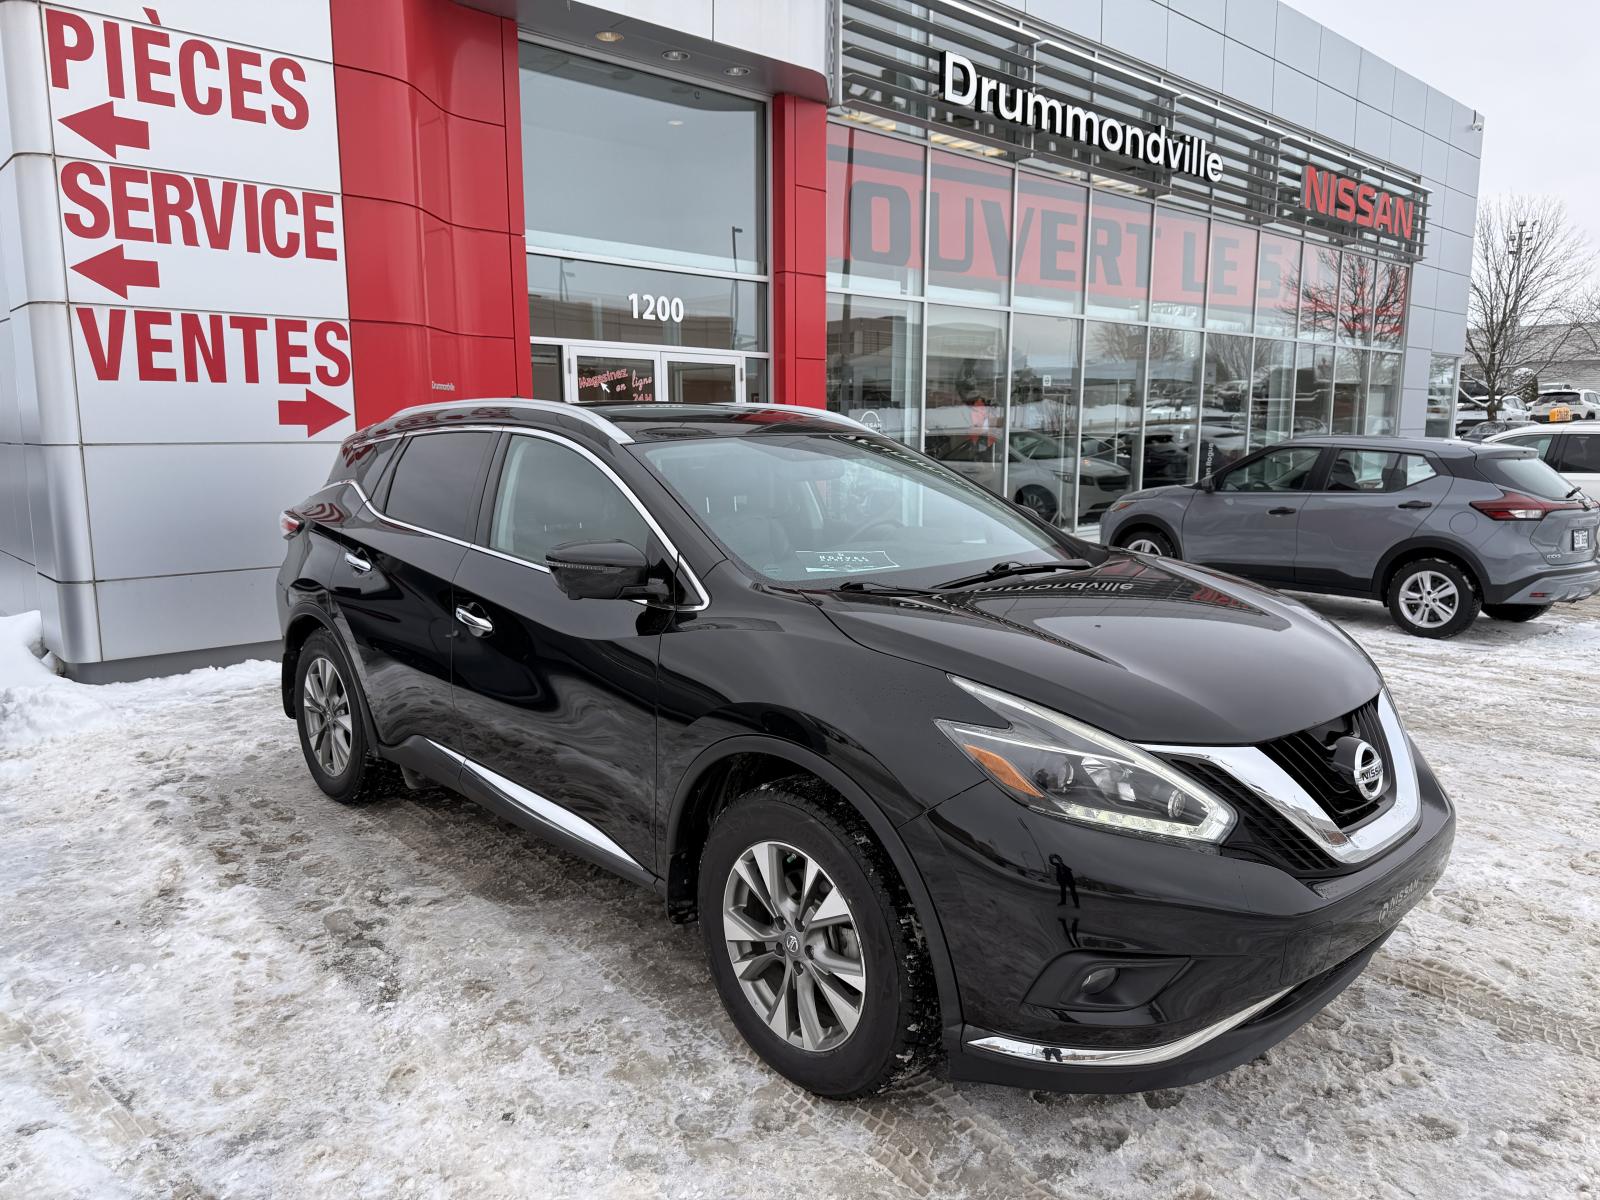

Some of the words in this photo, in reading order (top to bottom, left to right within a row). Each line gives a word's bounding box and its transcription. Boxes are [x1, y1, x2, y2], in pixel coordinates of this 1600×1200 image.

[45, 8, 310, 131] PIÈCES
[941, 50, 1225, 183] Drummondville
[61, 161, 339, 262] SERVICE
[850, 179, 1162, 289] OUVERT
[1302, 164, 1415, 240] NISSAN
[76, 307, 352, 388] VENTES
[627, 293, 685, 323] 1200
[631, 369, 653, 391] ligne
[1361, 764, 1383, 781] NISSA
